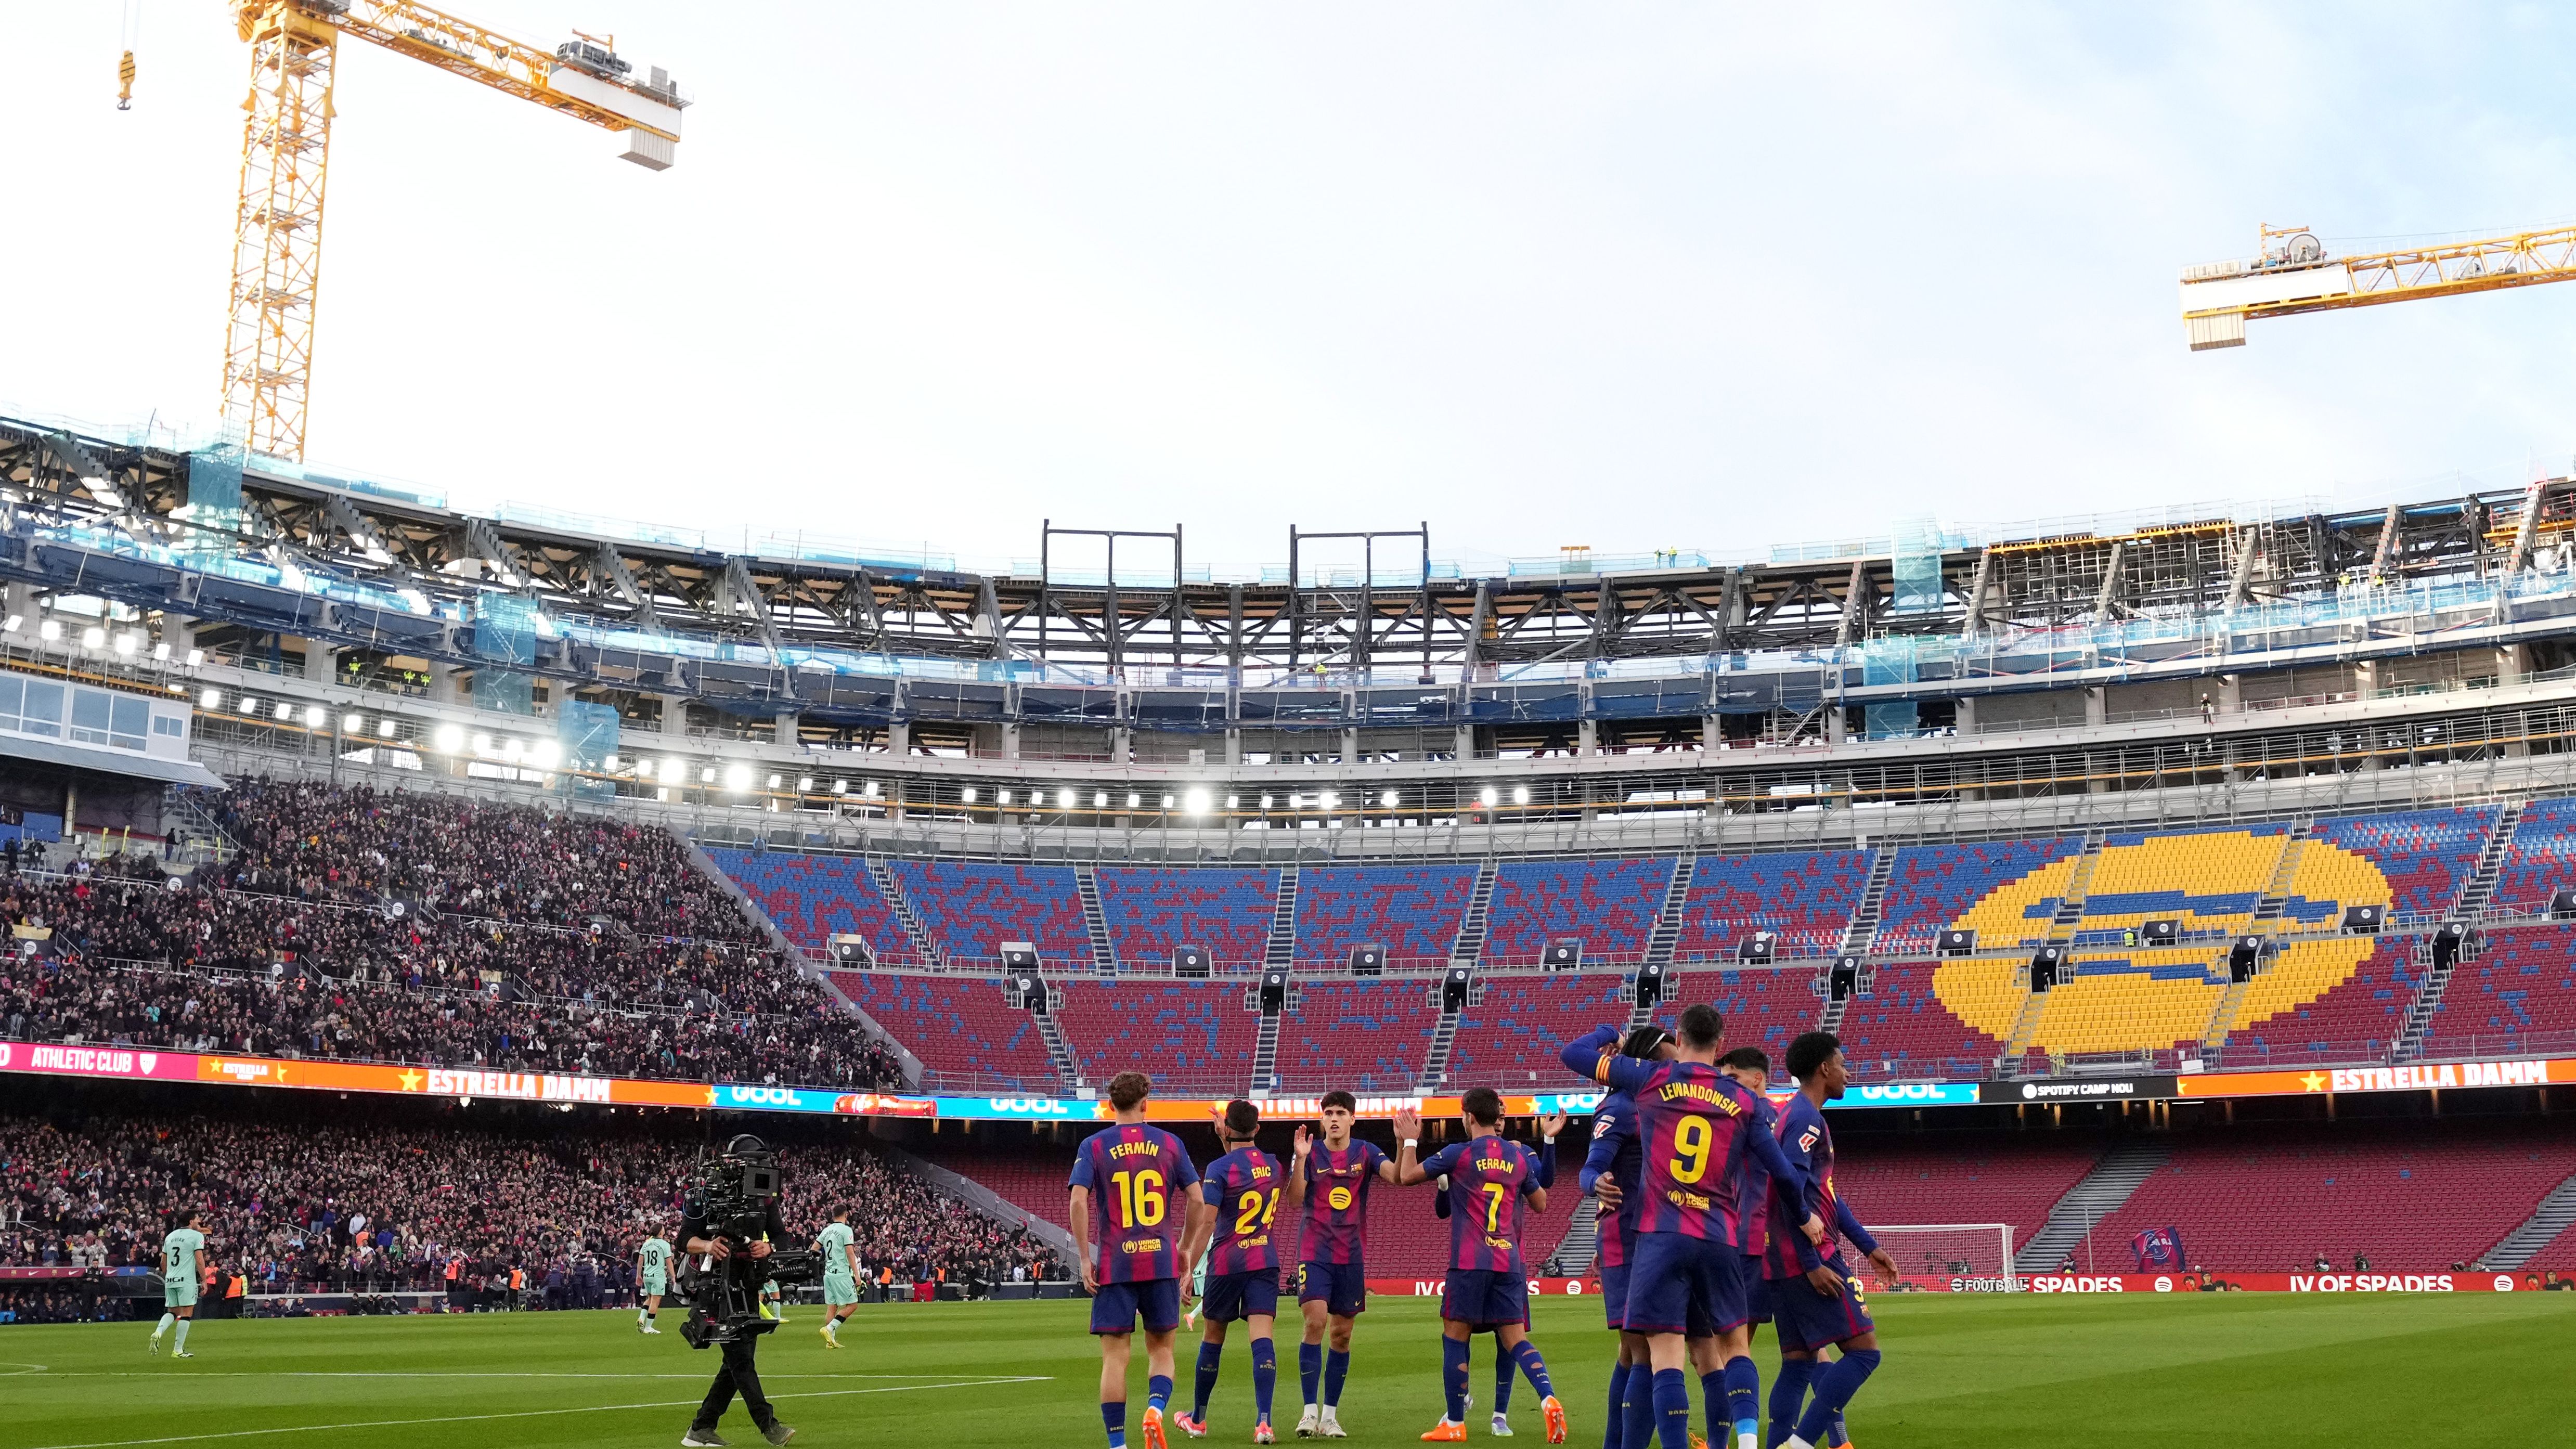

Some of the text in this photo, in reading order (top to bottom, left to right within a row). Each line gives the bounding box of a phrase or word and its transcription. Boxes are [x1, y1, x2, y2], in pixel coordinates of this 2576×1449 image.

[31, 1047, 132, 1072] ATHLETIC CLUB
[223, 1063, 268, 1076] ESTRELLA
[428, 1069, 610, 1102] ESTRELLA DAMM
[2331, 1060, 2548, 1091] ESTRELLA DAMM
[1659, 1082, 1742, 1117] LEWANDOWSKI
[2038, 1083, 2133, 1096] SPOTIFY CAMP NOU
[1109, 1141, 1159, 1160] FERMÍN
[1669, 1115, 1712, 1184] 9
[1251, 1166, 1271, 1179] ERIC
[1475, 1158, 1514, 1174] FERRAN
[1111, 1169, 1164, 1228] 16
[1482, 1183, 1504, 1232] 7
[1235, 1188, 1280, 1235] 24
[171, 1247, 180, 1267] 3
[646, 1250, 657, 1266] 18
[826, 1239, 833, 1260] 2
[1415, 1282, 1434, 1296] IV
[2034, 1276, 2122, 1293] SPADES
[2290, 1275, 2453, 1292] IV OF SPADES
